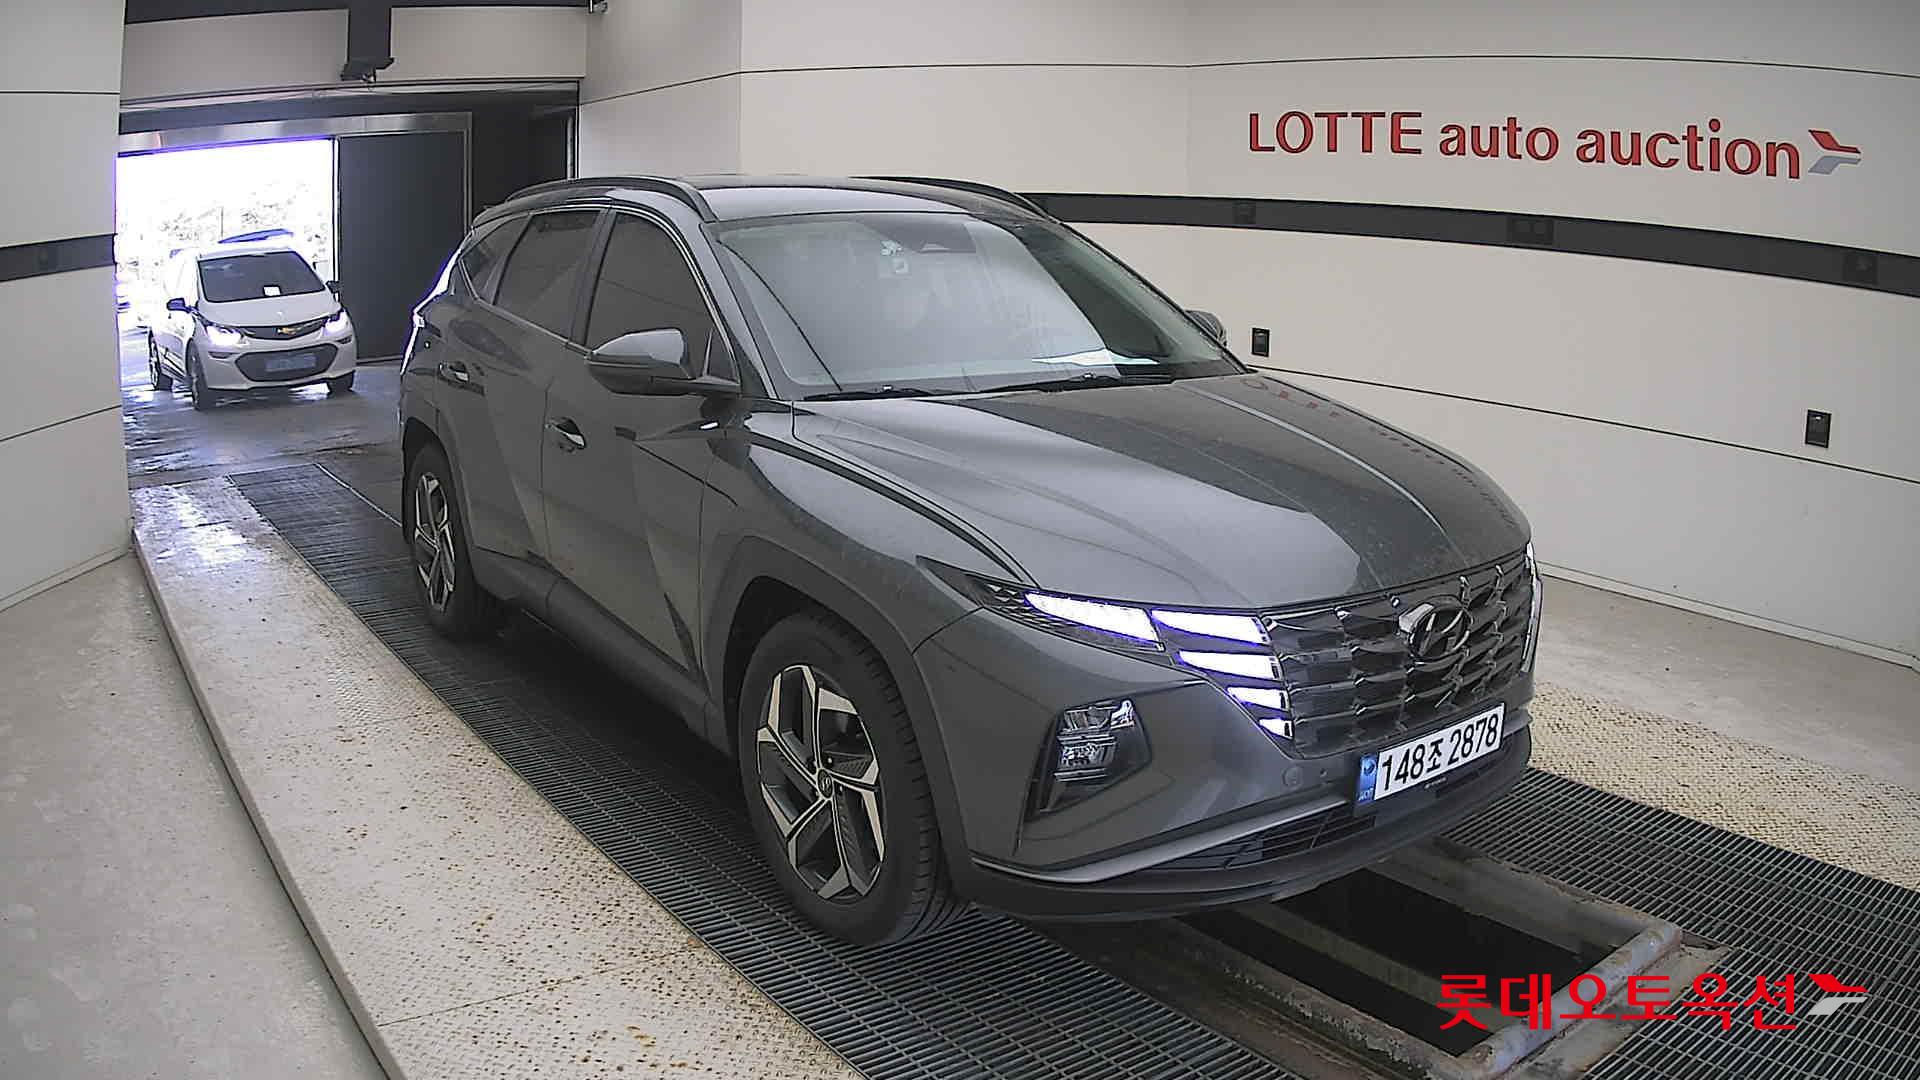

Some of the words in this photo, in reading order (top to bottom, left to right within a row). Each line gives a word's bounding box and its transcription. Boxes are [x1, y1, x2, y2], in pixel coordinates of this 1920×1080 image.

[1249, 111, 1422, 155] LOTTE
[1439, 117, 1560, 161] auto
[1576, 118, 1801, 180] auction
[1381, 737, 1444, 791] 148조
[1447, 713, 1499, 766] 2878
